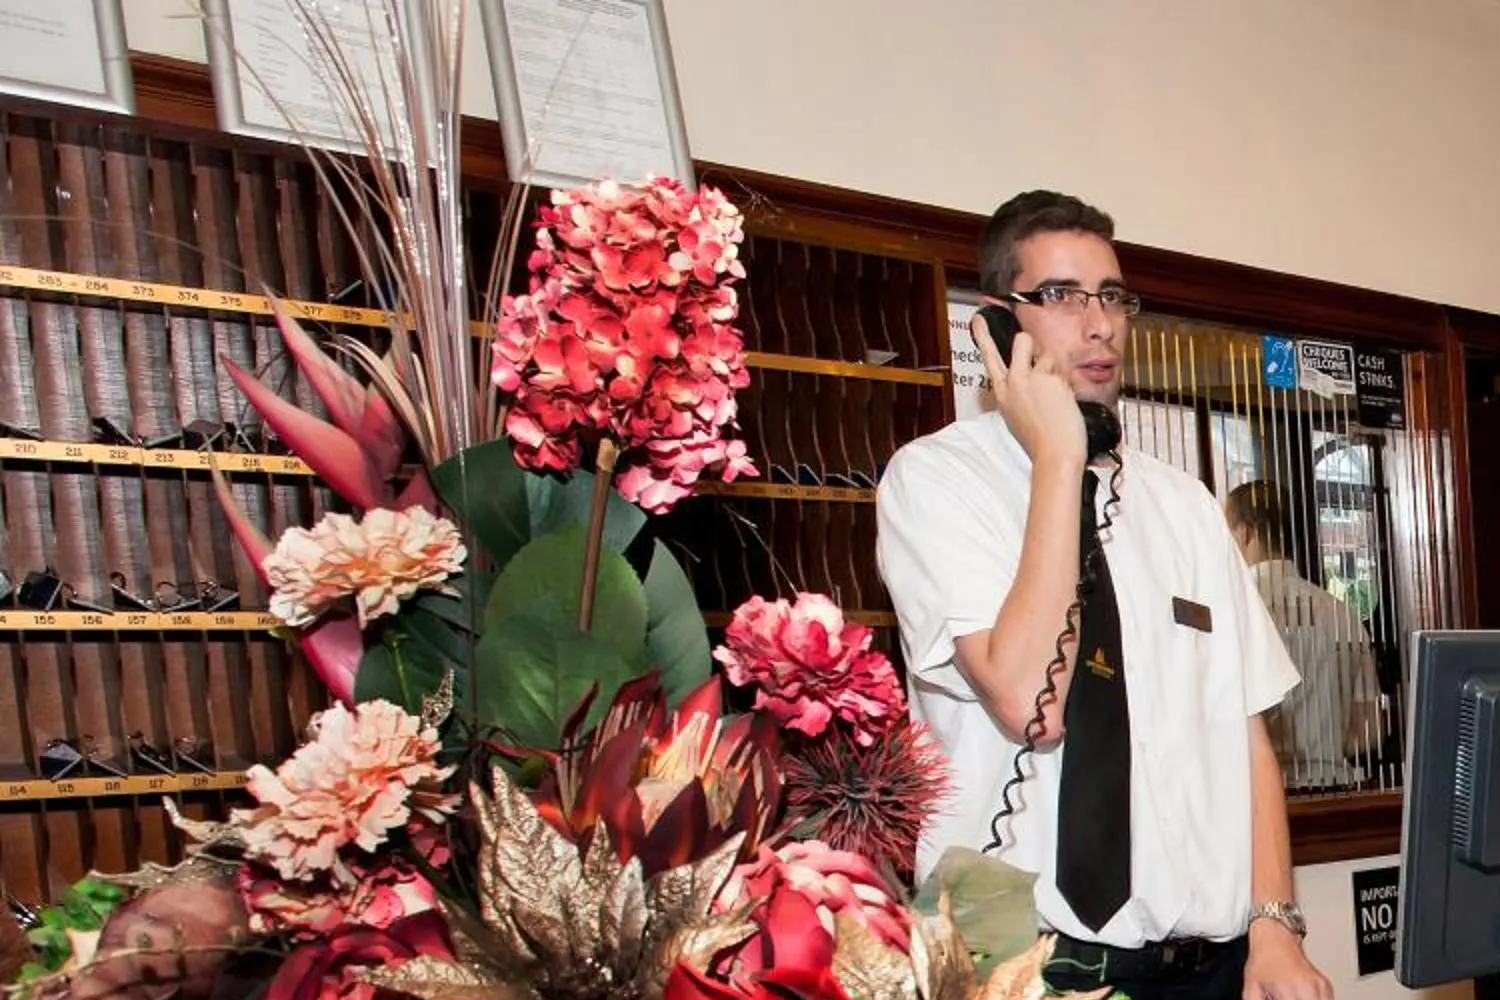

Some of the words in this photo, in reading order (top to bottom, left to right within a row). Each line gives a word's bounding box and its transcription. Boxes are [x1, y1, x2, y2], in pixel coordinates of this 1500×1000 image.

[177, 290, 199, 302] 374
[1357, 353, 1386, 370] CASH
[65, 445, 83, 457] 211
[109, 448, 129, 460] 212
[154, 452, 175, 464] 213
[199, 454, 211, 464] 21
[1360, 885, 1399, 902] IMPORT
[1361, 903, 1393, 932] NO
